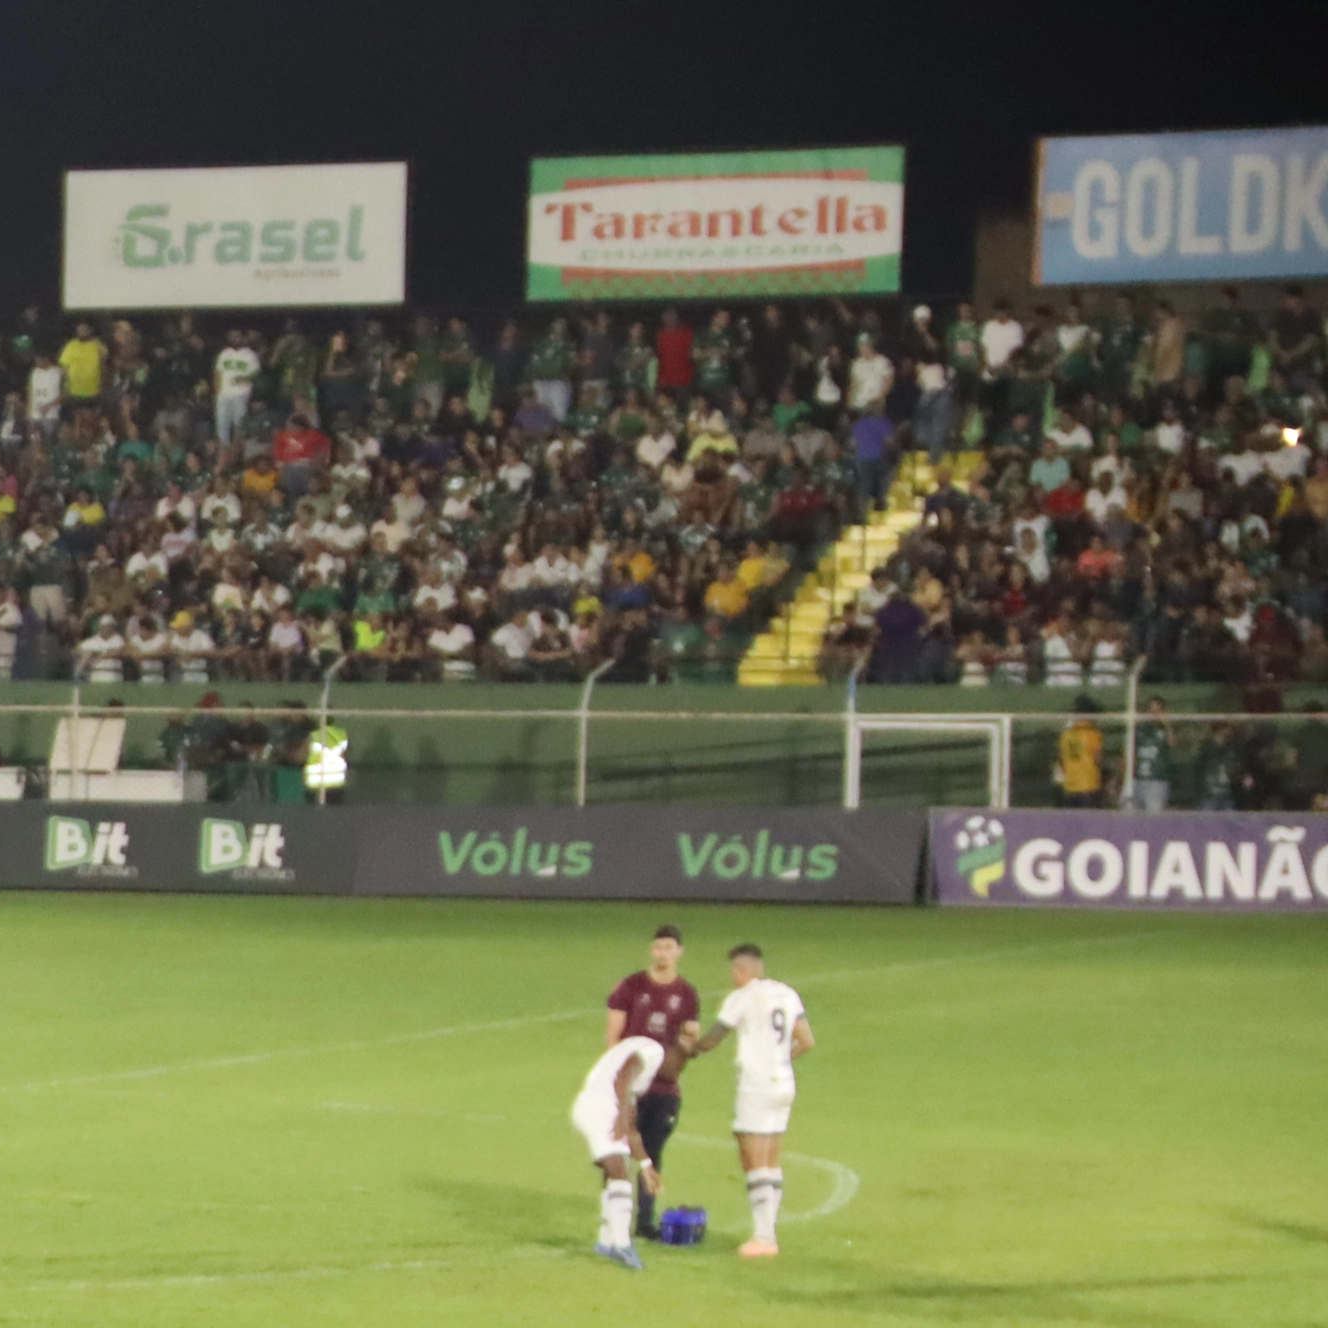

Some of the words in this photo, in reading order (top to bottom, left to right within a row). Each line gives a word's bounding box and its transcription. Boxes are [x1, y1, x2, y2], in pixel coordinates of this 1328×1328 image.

[544, 195, 888, 241] Tarantella
[56, 820, 130, 865] Bit
[210, 822, 285, 869] Bit
[438, 826, 594, 878] Vólus
[676, 828, 840, 881] Vólus
[771, 1007, 786, 1044] 9
